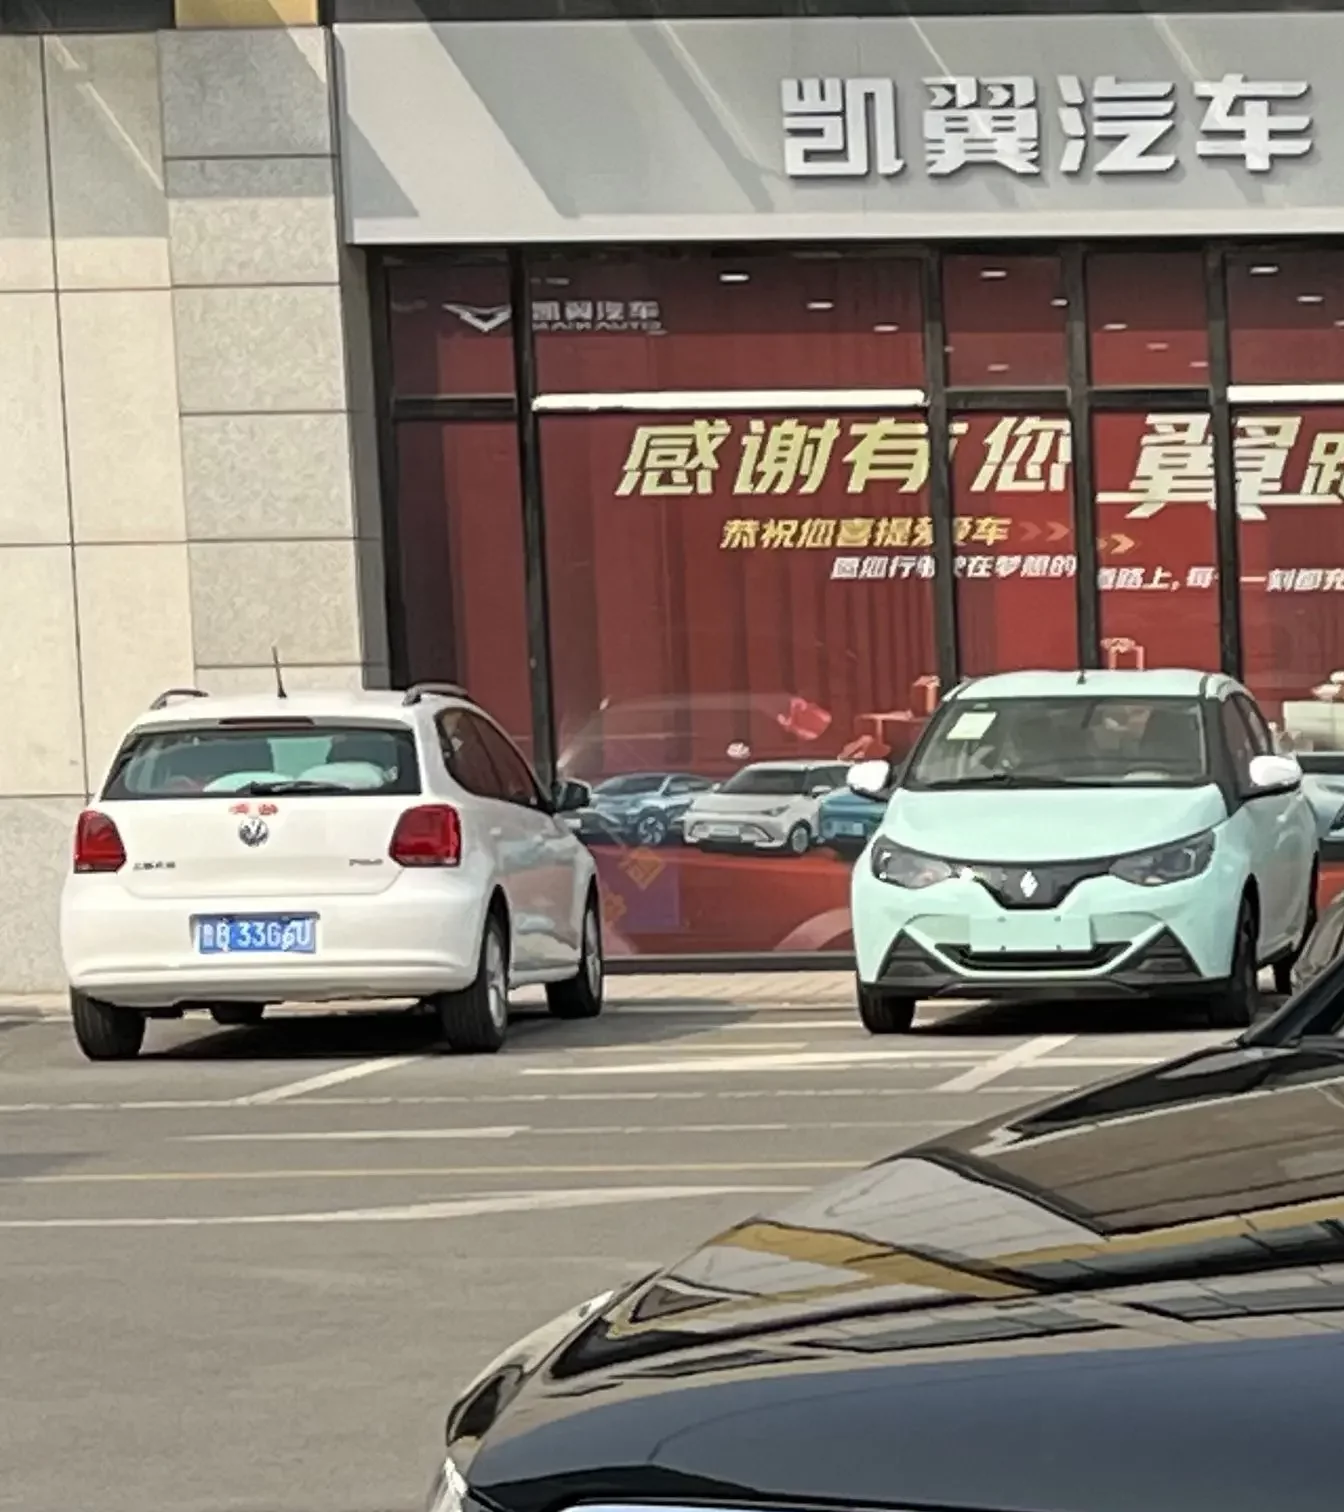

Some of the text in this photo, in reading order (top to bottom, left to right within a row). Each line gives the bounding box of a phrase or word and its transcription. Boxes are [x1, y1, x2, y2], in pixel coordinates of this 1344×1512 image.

[781, 73, 1313, 178] 凯翼汽车
[615, 416, 1073, 497] 感谢有您
